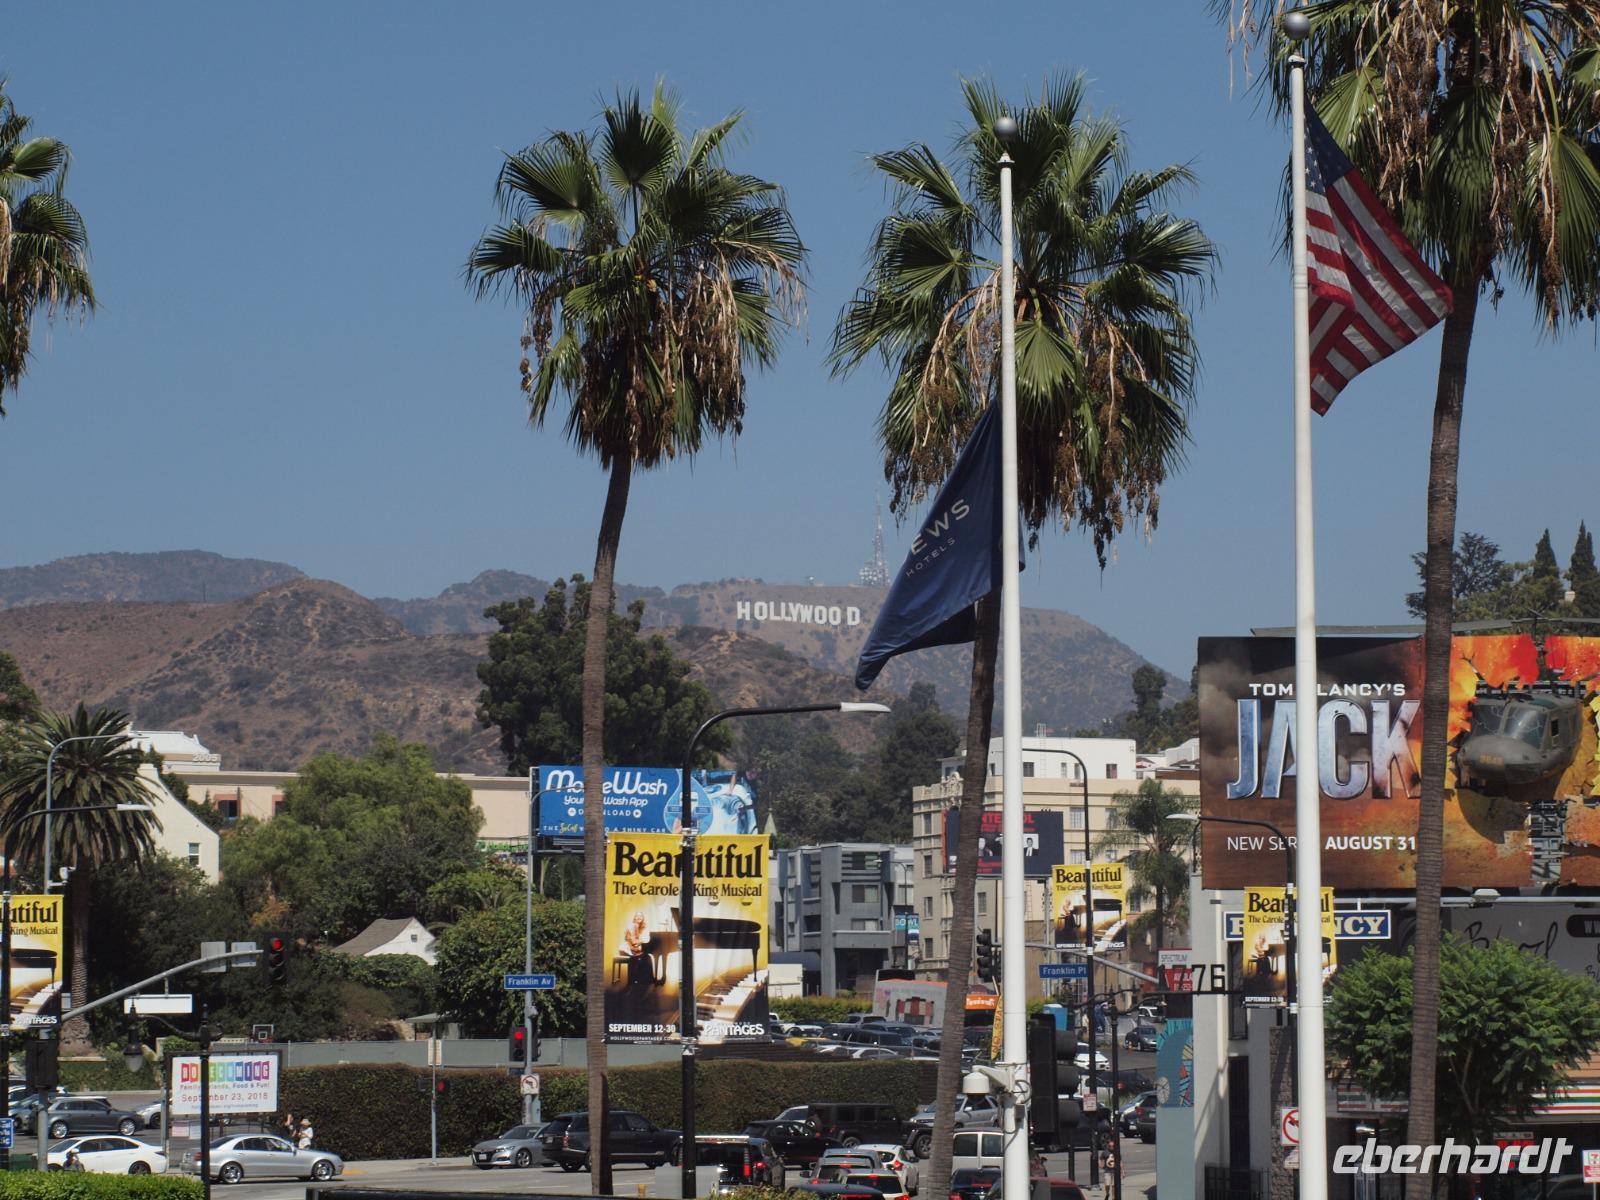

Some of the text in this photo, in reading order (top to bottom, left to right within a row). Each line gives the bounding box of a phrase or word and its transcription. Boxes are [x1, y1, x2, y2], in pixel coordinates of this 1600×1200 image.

[906, 537, 956, 577] HOTELS
[737, 601, 860, 626] HOLLYWOOD
[1249, 683, 1405, 696] TOM LANCY'S
[1227, 699, 1420, 799] JACK
[545, 769, 668, 795] MoeWash
[603, 797, 628, 806] Wash
[629, 797, 648, 807] App
[1227, 836, 1416, 850] NEW SER AUGUST 31
[613, 842, 763, 878] Beautiful
[613, 881, 762, 898] The Carole King Musical
[1043, 966, 1087, 975] Franklin Pl
[508, 978, 539, 986] Franklin
[608, 1023, 676, 1033] SEPTEMBER 12-30
[704, 1023, 765, 1036] PANTAGES
[181, 1061, 270, 1082] HOECOMING
